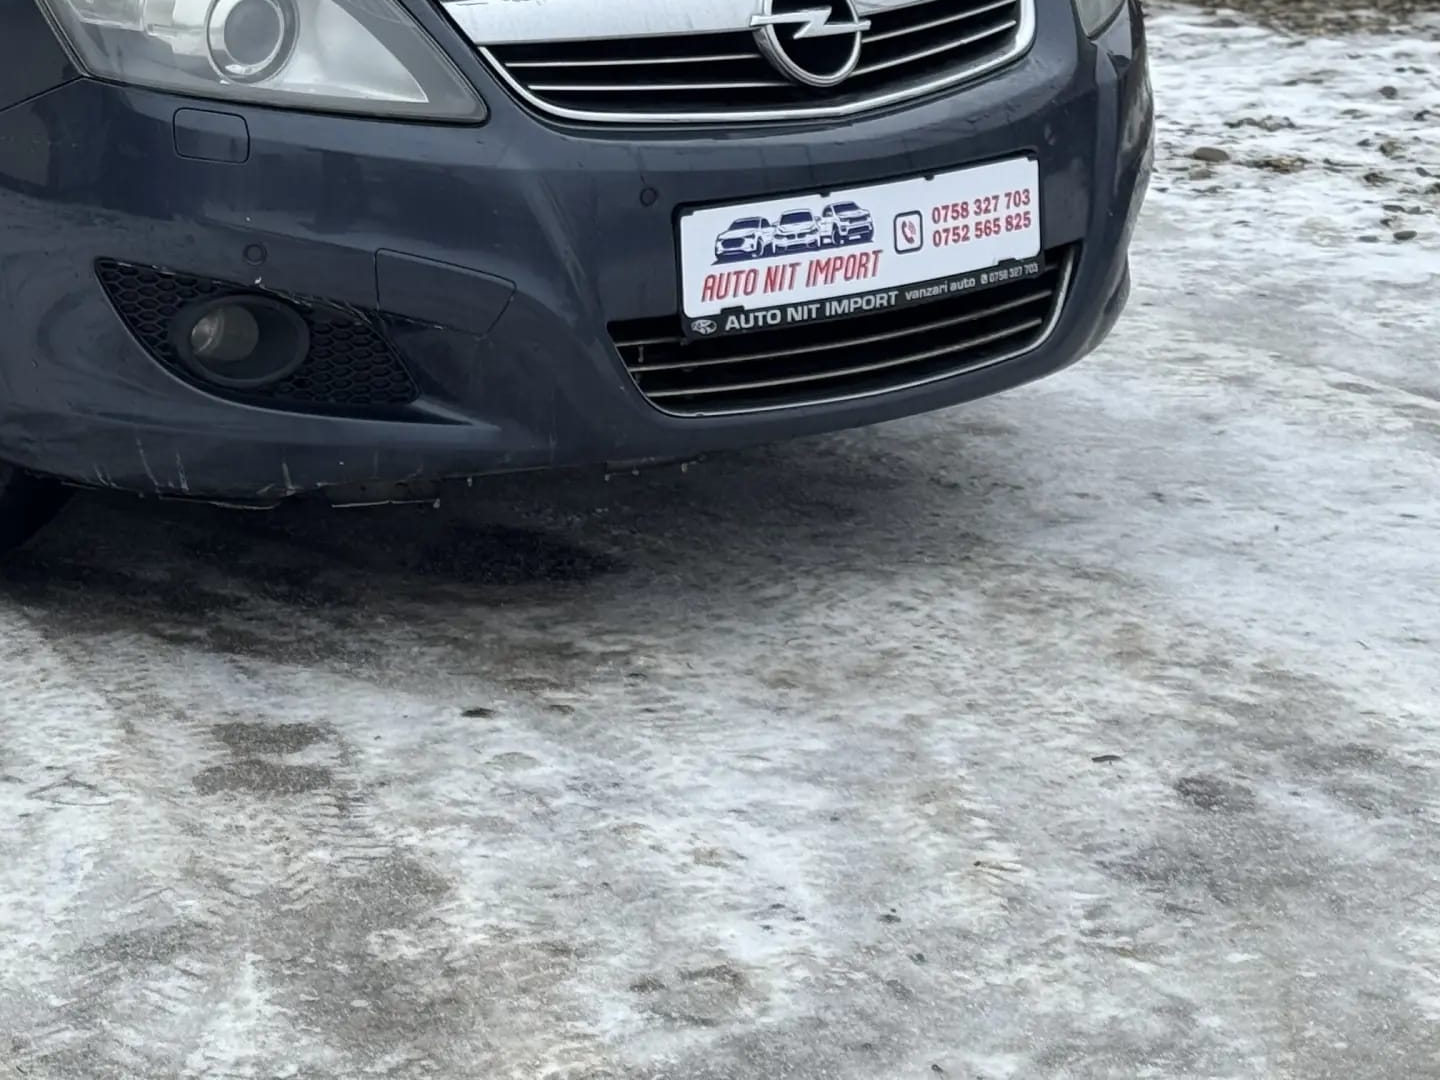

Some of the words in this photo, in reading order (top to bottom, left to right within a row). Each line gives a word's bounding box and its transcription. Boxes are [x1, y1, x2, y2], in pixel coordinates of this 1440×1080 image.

[931, 201, 969, 224] 0758
[974, 195, 1000, 216] 327
[1004, 188, 1031, 210] 703
[933, 224, 970, 247] 0752
[974, 217, 1001, 238] 565
[1005, 211, 1031, 232] 825
[701, 268, 759, 302] AUTO
[763, 262, 802, 294] NIT
[805, 250, 883, 288] IMPORT
[725, 309, 781, 331] AUTO
[787, 304, 820, 322] NIT
[825, 291, 899, 317] IMPORT
[905, 280, 948, 300] vanzari
[950, 277, 976, 292] auto
[989, 269, 1008, 282] 0758
[1024, 262, 1039, 274] 703
